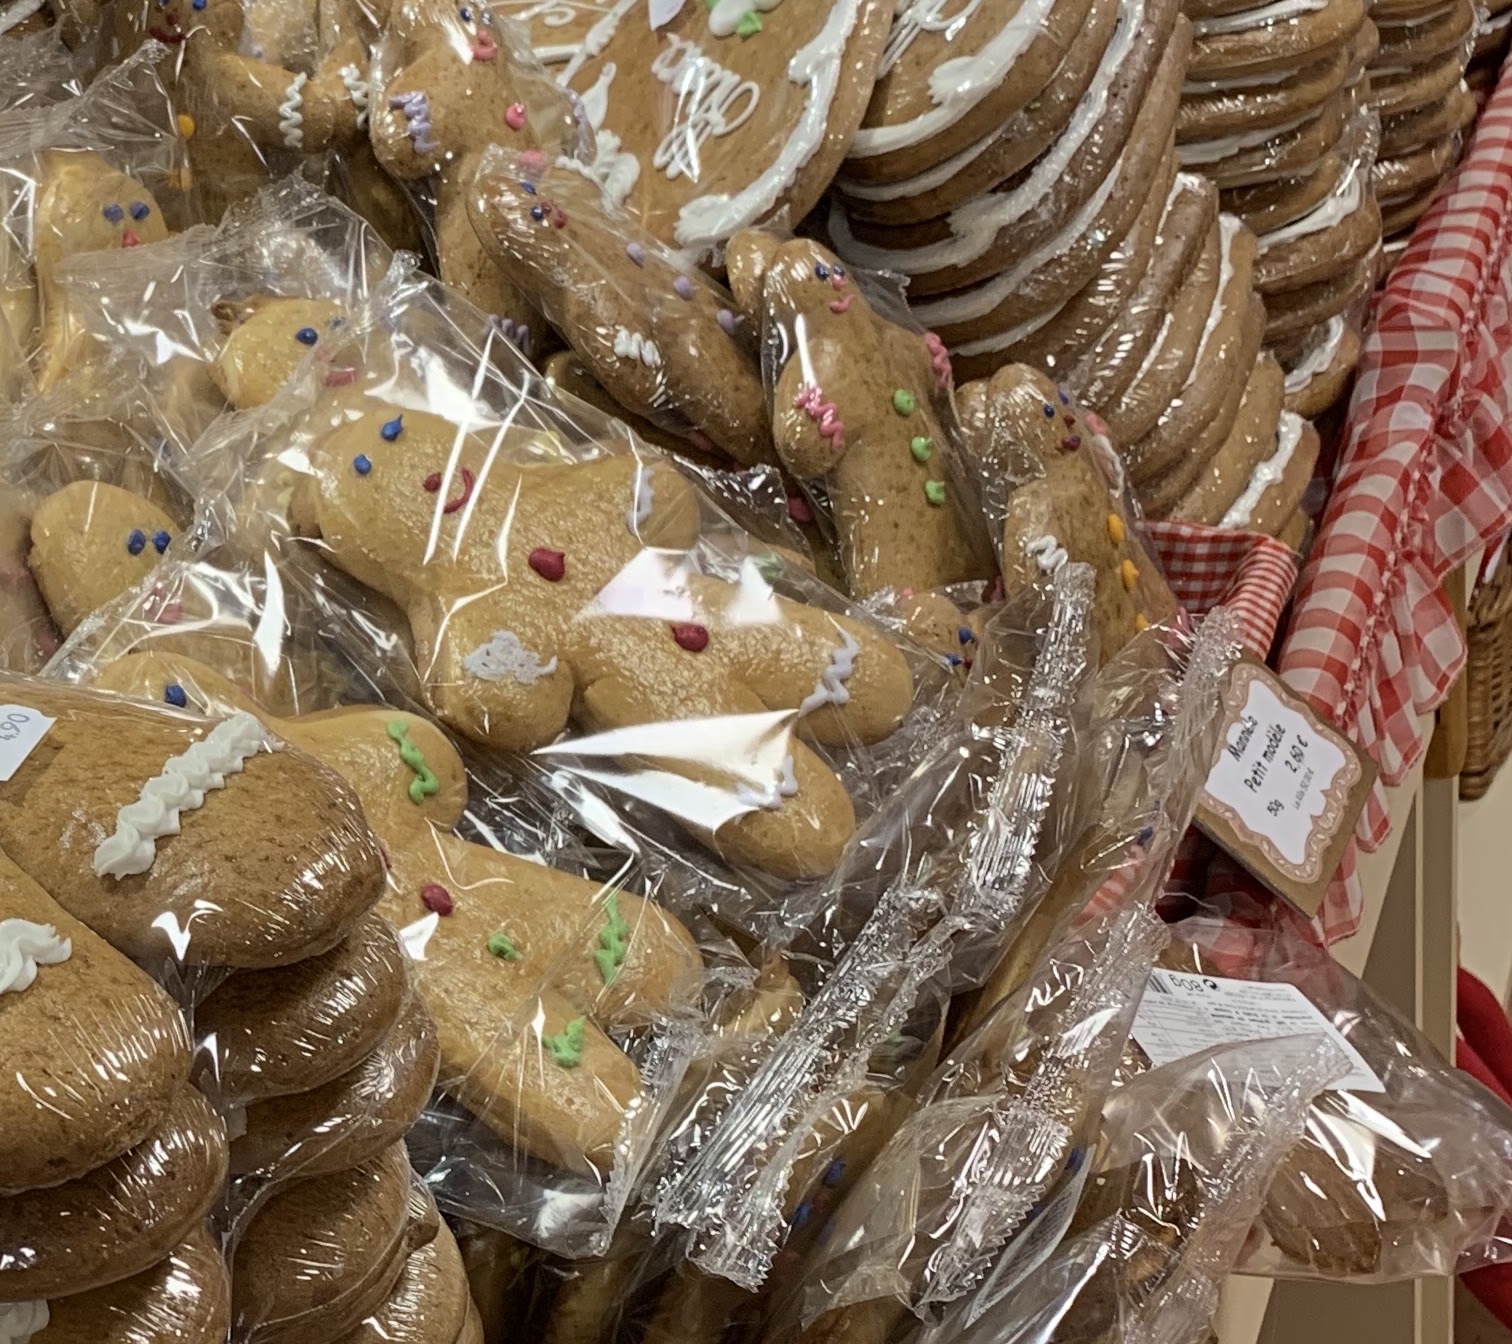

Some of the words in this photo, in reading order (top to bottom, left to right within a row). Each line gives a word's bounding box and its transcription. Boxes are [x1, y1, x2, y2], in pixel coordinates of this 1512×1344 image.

[1297, 734, 1308, 747] €
[1244, 761, 1268, 793] Petit
[1262, 723, 1286, 763] modèle
[1168, 973, 1205, 993] 80g
